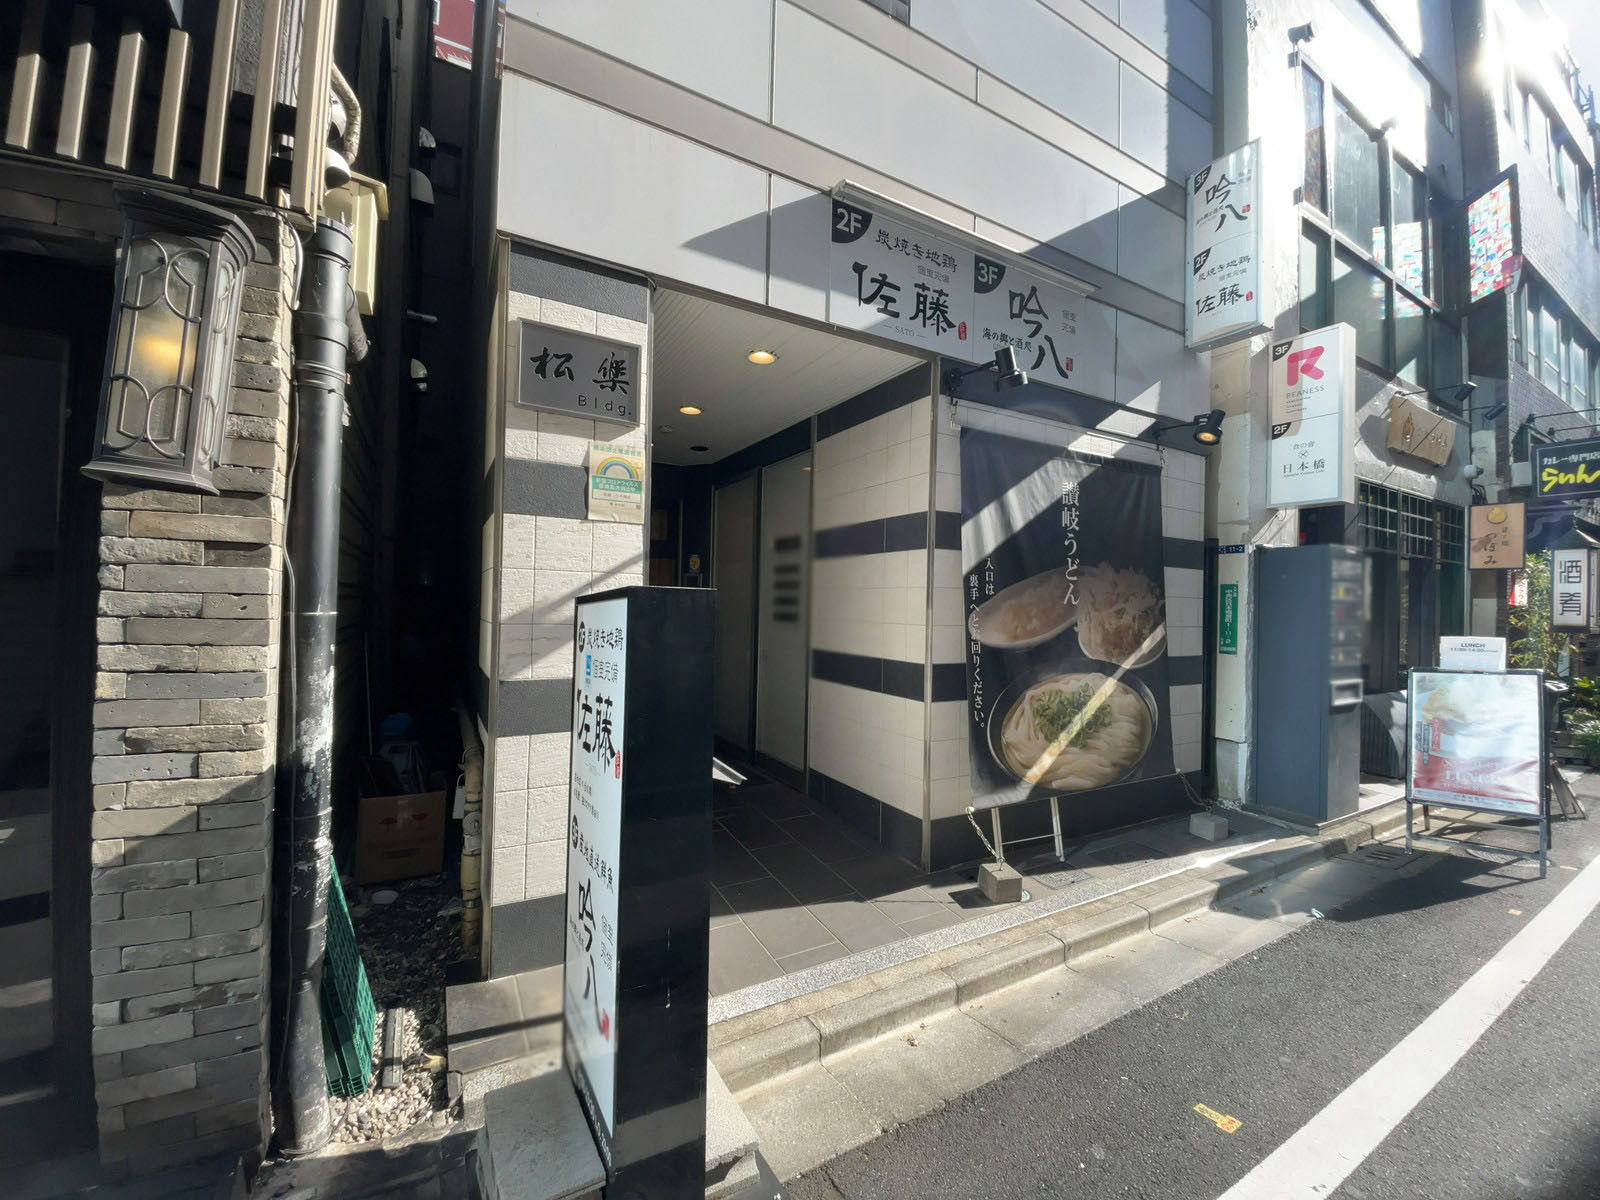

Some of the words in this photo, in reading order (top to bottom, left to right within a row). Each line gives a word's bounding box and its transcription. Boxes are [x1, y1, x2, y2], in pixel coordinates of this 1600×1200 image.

[1196, 170, 1209, 188] 3F
[1205, 173, 1249, 233] 吟八
[836, 208, 863, 234] 2F
[1195, 252, 1208, 270] 2F
[978, 262, 999, 285] 3F
[852, 261, 956, 337] 佐藤
[1196, 283, 1244, 316] 佐藤
[895, 325, 915, 338] SATO
[1008, 285, 1069, 379] 吟八
[1275, 345, 1289, 356] 3F
[1286, 384, 1325, 399] REANESS
[577, 394, 632, 416] Bldg.
[1274, 424, 1288, 435] 2F
[1283, 458, 1325, 475] 日本橋
[1060, 481, 1081, 606] 讃岐うどん
[985, 558, 996, 597] 入口は
[577, 688, 616, 775] 佐藤
[578, 877, 604, 1036] 吟八
